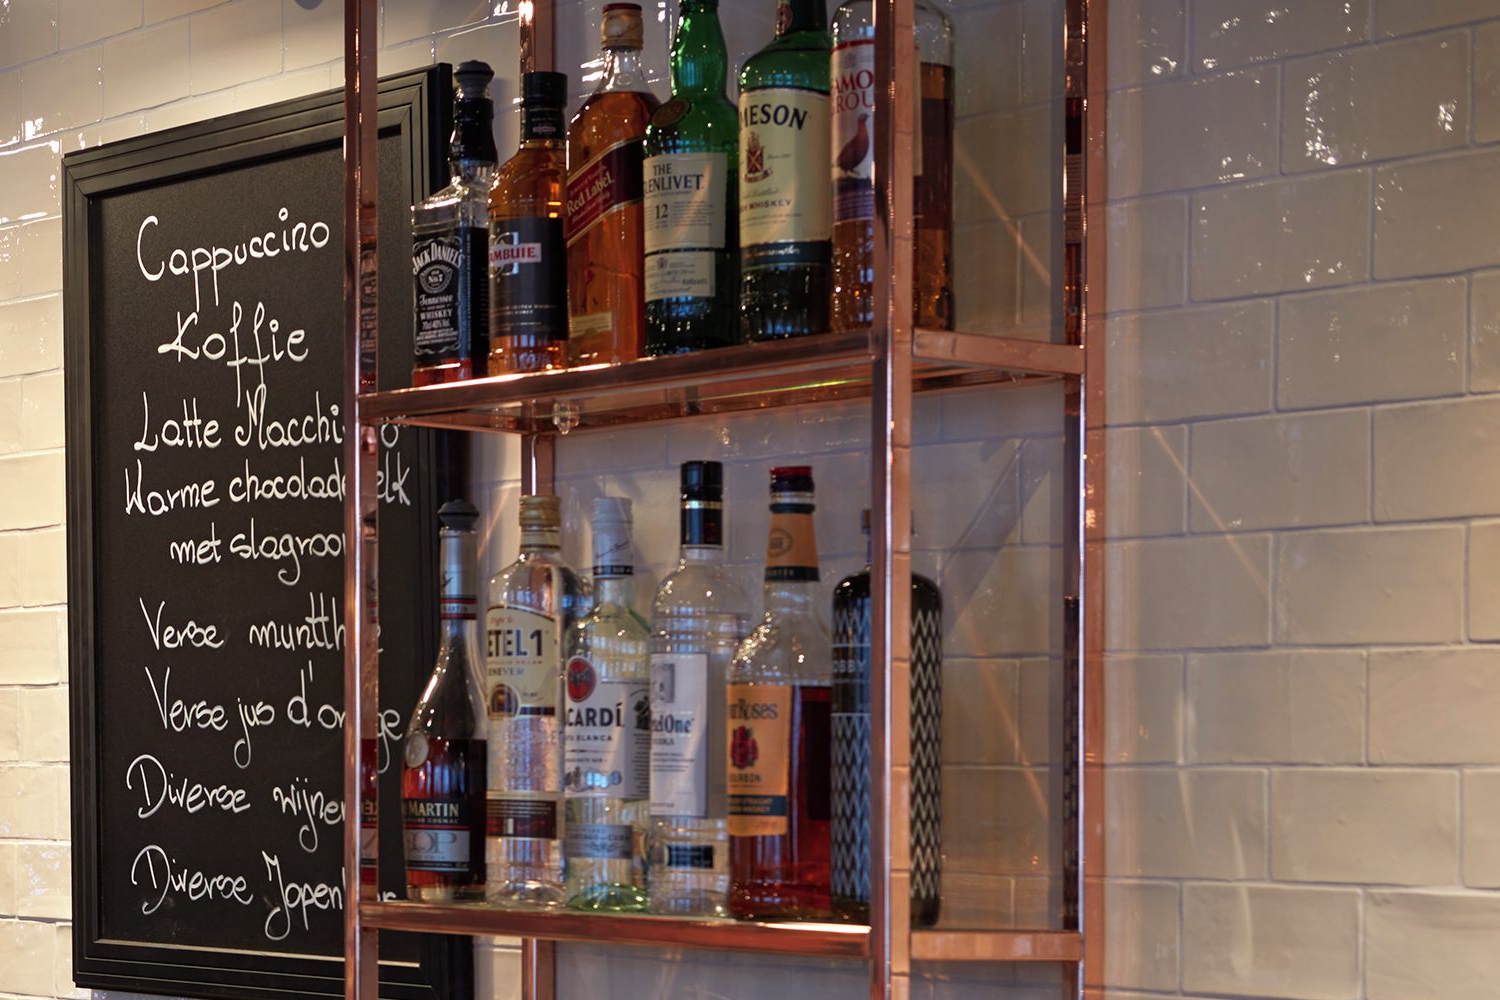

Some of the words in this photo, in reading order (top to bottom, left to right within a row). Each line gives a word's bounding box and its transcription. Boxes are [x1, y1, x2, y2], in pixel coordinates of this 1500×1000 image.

[566, 190, 586, 216] Red
[585, 171, 612, 201] Label
[652, 163, 673, 176] THE
[655, 203, 669, 220] 12
[137, 207, 330, 313] Cappuccino
[412, 247, 432, 276] JACK
[157, 301, 309, 408] Koffie
[134, 391, 222, 452] Latte
[235, 383, 399, 450] Macchio
[124, 458, 221, 515] Warme
[170, 522, 222, 565] met
[229, 517, 346, 586] slagroo
[139, 597, 225, 650] Verse
[145, 666, 229, 732] Verse
[233, 697, 276, 769] jus
[126, 754, 251, 819] Diverse
[408, 800, 460, 818] MARTIN
[131, 844, 253, 915] Diverse
